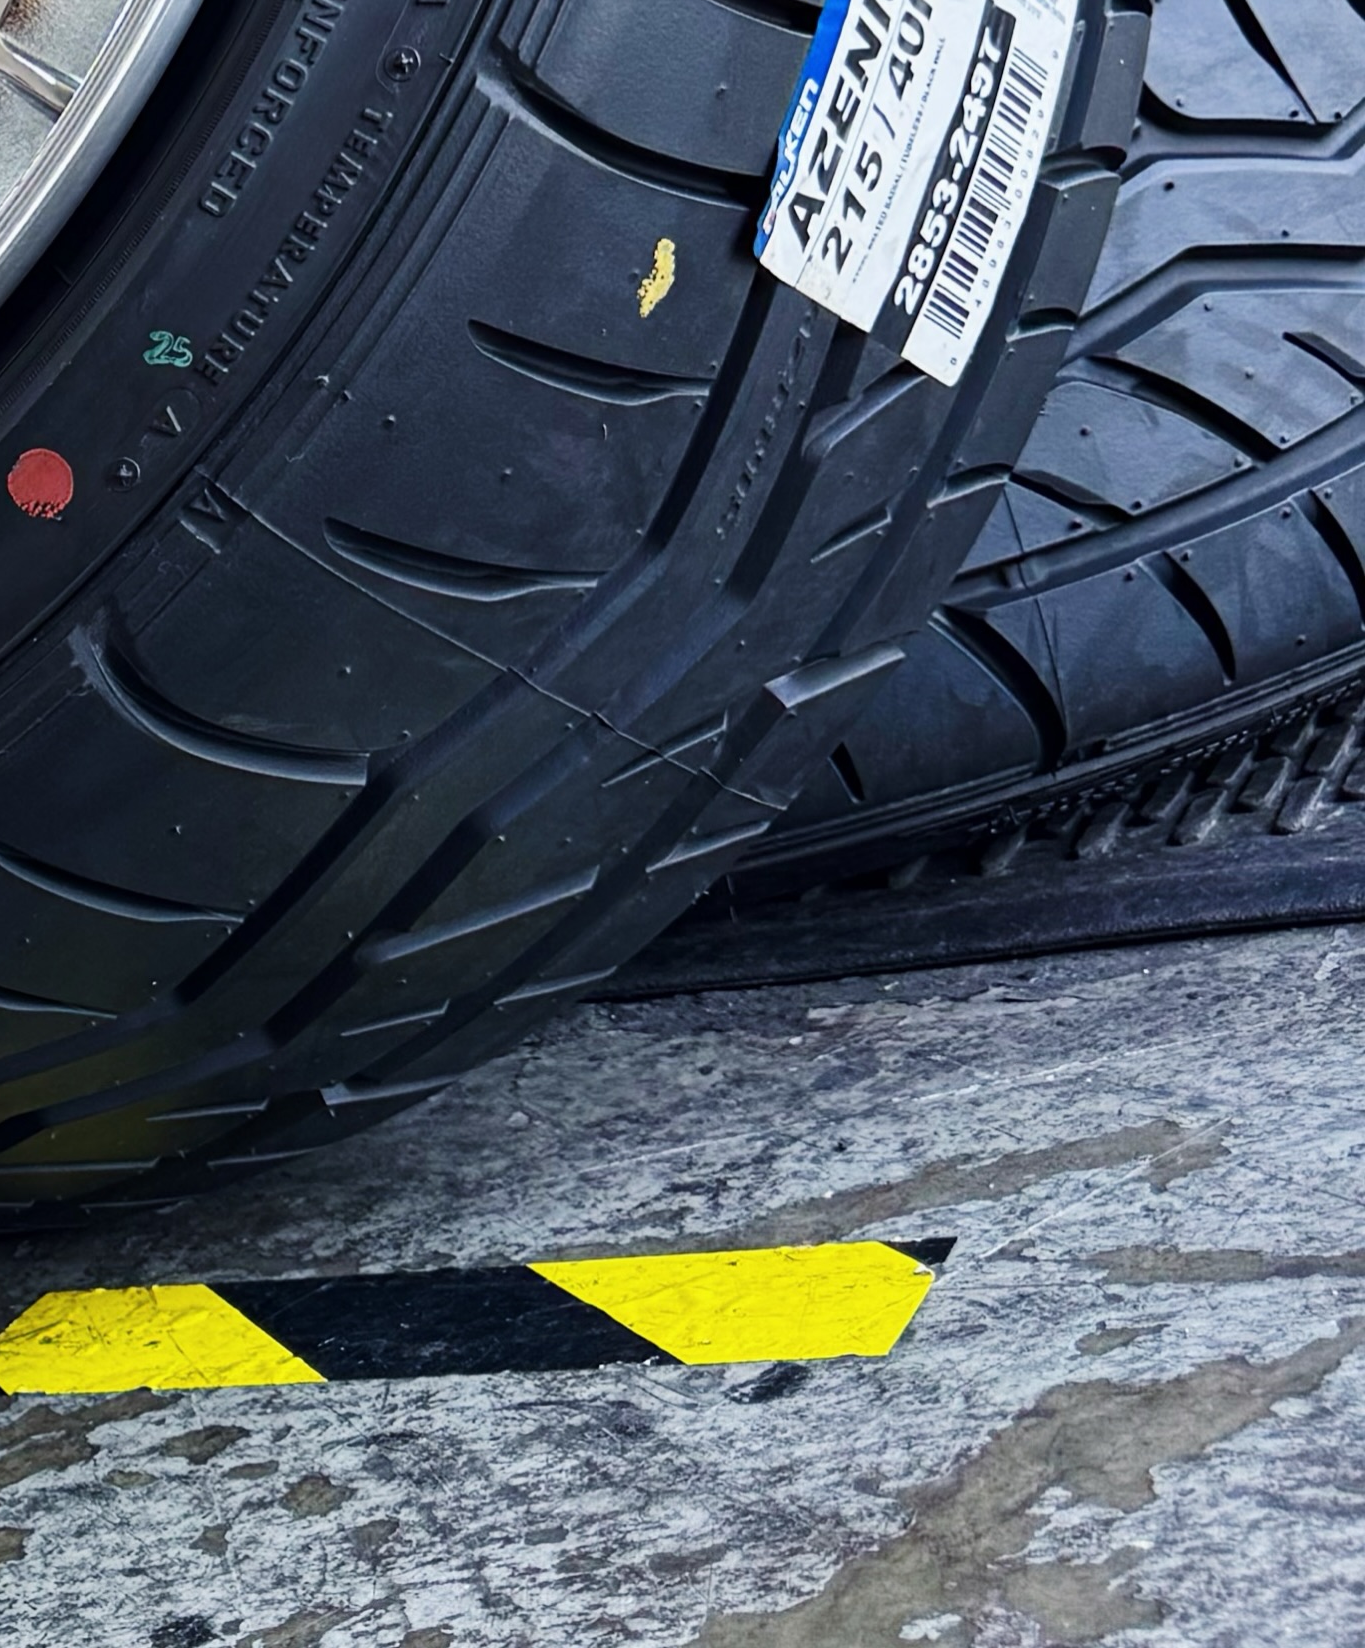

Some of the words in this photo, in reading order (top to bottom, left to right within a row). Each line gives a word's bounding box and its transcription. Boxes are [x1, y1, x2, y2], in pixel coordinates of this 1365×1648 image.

[819, 142, 885, 275] 215
[892, 26, 1004, 315] 2853-2497
[193, 111, 394, 389] TEMPERATURE
[143, 329, 194, 369] 25
[148, 405, 182, 440] A
